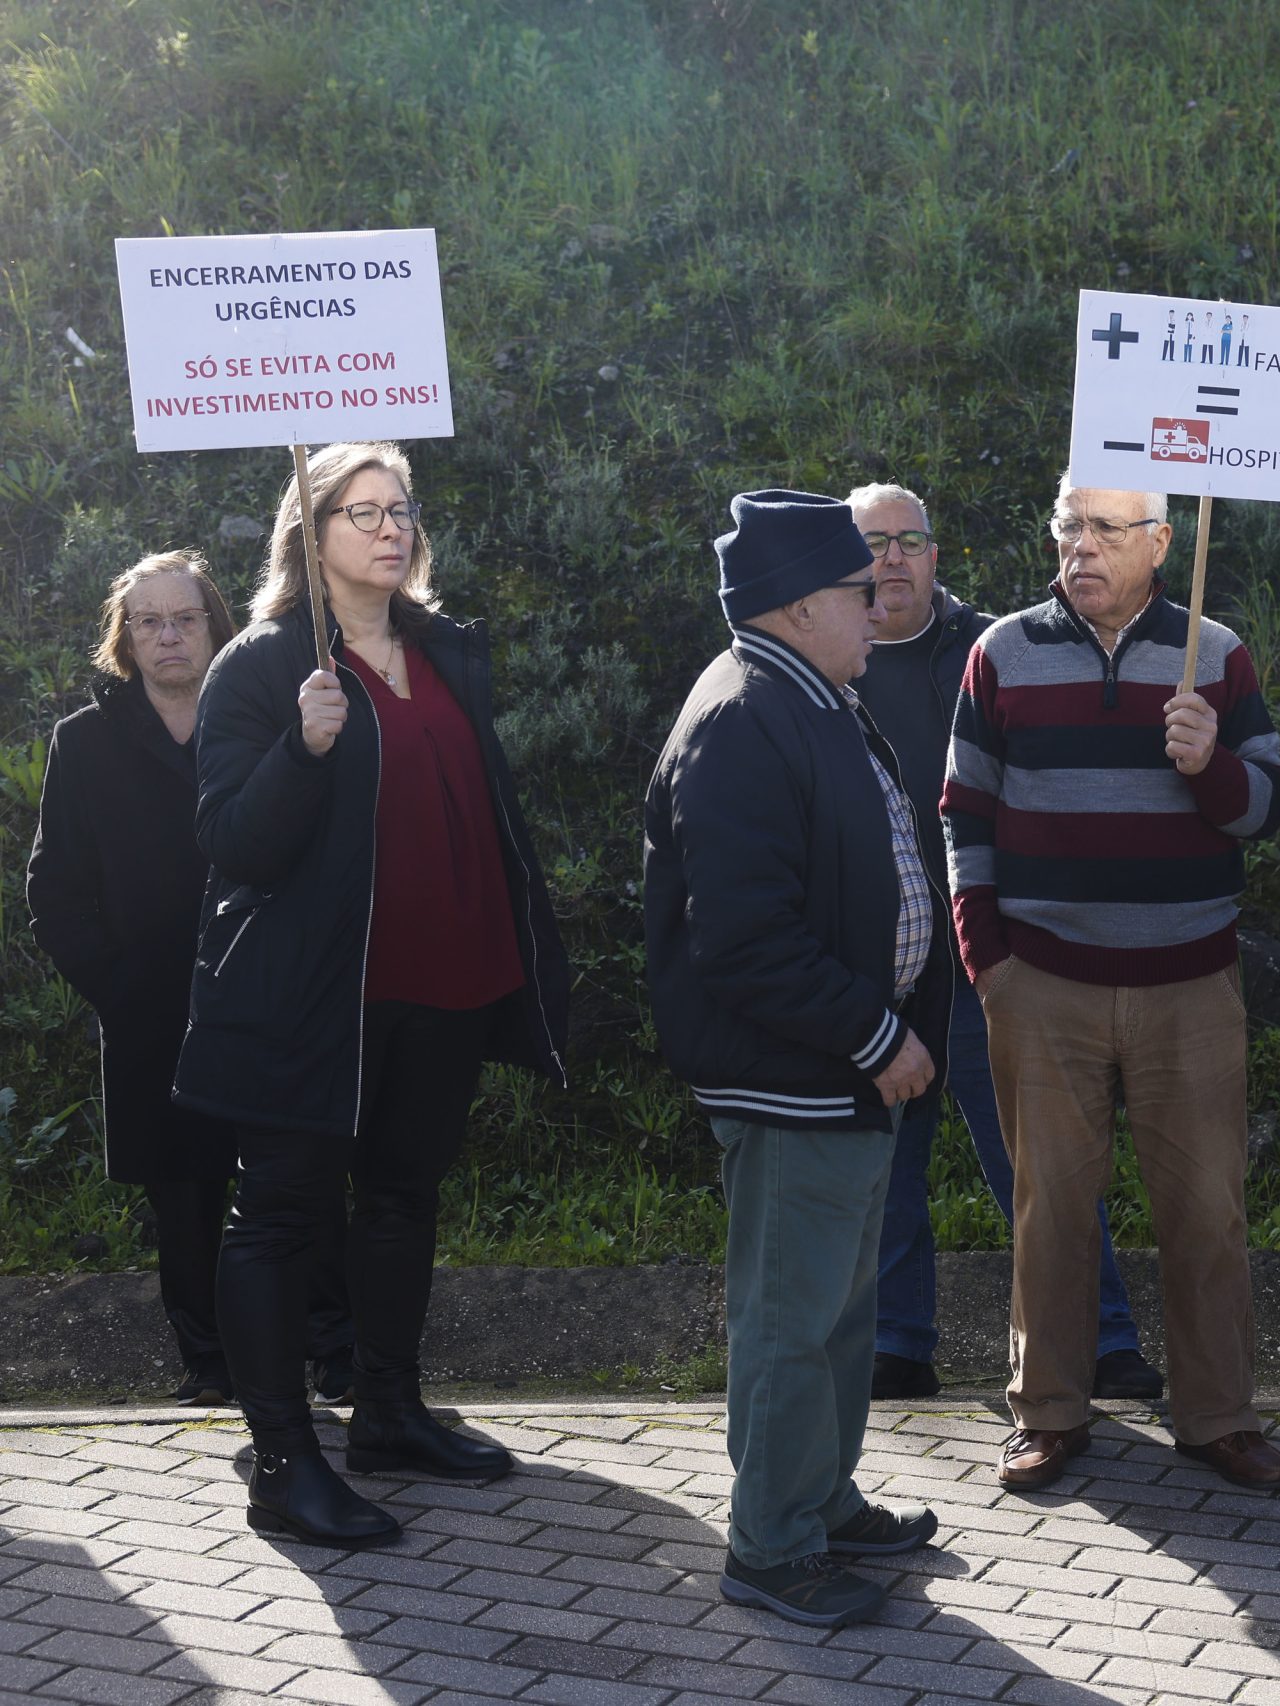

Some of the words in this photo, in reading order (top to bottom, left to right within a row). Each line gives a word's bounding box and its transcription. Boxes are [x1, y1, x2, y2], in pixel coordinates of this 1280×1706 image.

[150, 262, 356, 287] ENCERRAMENTO
[364, 260, 411, 279] DAS
[216, 296, 355, 321] URGÊNCIAS
[185, 355, 217, 379] SÓ
[226, 358, 252, 377] SE
[261, 355, 330, 375] EVITA
[338, 352, 395, 372] COM
[147, 391, 333, 417] INVESTIMENTO
[342, 389, 377, 407] NO
[386, 384, 438, 405] SNS!
